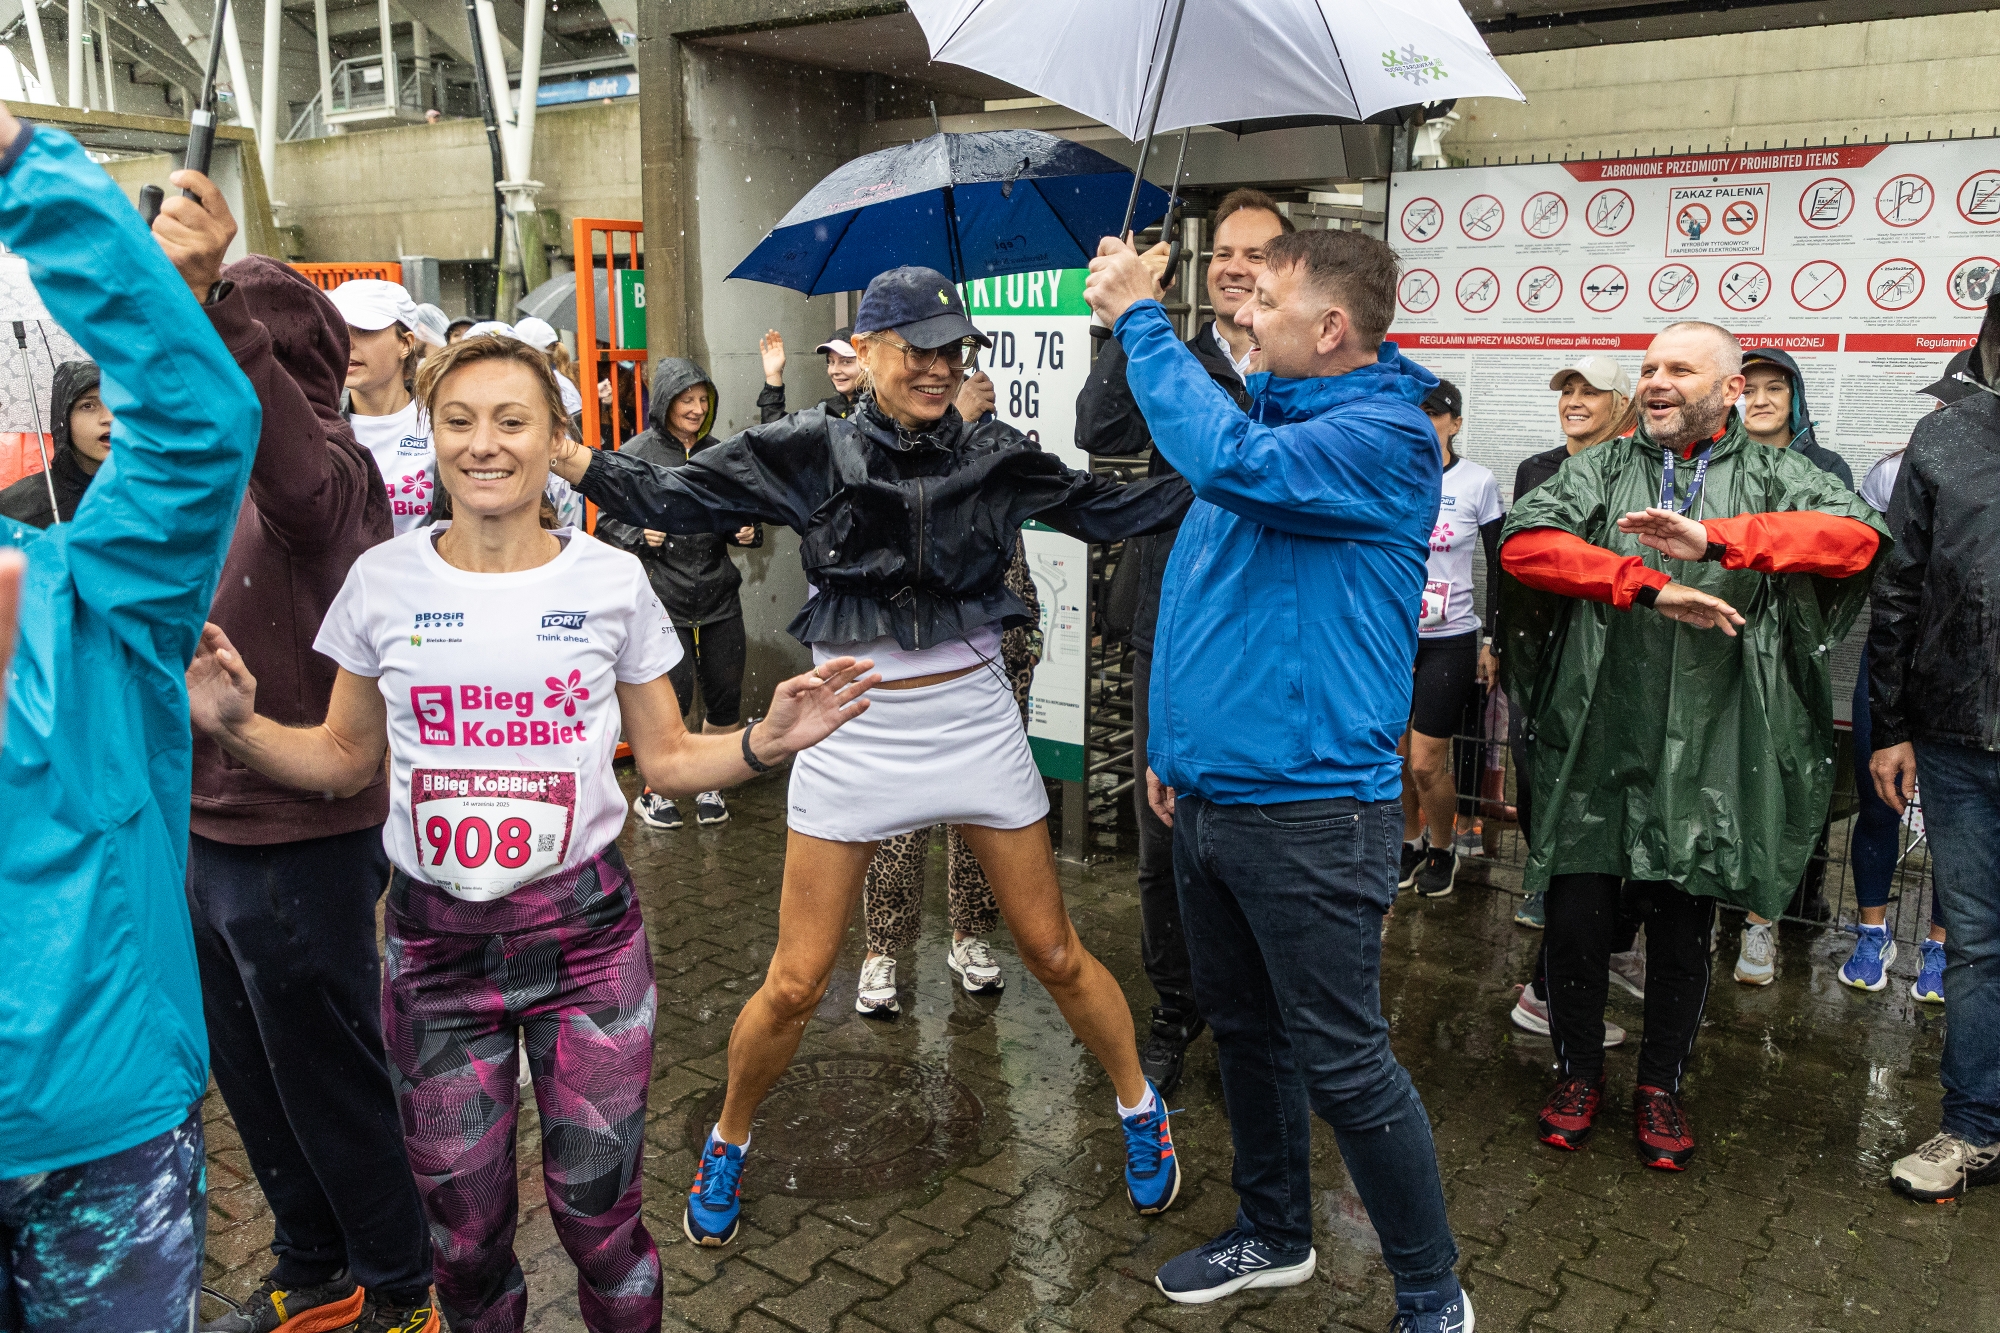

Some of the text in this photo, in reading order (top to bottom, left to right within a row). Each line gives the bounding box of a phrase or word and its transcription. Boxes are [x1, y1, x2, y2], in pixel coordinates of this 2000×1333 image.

[588, 79, 618, 97] Bufet
[1601, 162, 1664, 178] ZABRONIONE
[1666, 159, 1730, 174] PRZEDMIOTY
[1740, 155, 1802, 171] PROHIBITED
[1804, 152, 1839, 167] ITEMS
[1675, 187, 1764, 199] ZAKAZ PALENIA
[1419, 335, 1620, 347] REGULAMIN IMPREZY MASOWEJ (meczu piłki nożnej)
[1760, 337, 1784, 347] PIŁKI
[1786, 336, 1825, 347] NOŻNEJ
[1916, 337, 1967, 349] Regulamin
[1034, 331, 1064, 370] 7G
[1009, 380, 1040, 419] 8G
[401, 440, 426, 448] TORK
[415, 612, 464, 622] BBOSiR
[543, 615, 585, 627] TORK
[536, 634, 592, 644] Think ahead.
[417, 692, 446, 724] 5
[460, 685, 534, 718] Bieg
[425, 725, 450, 741] km
[462, 720, 588, 748] KoBBiet
[434, 775, 468, 795] Bieg
[474, 775, 547, 793] KoBBiet
[425, 815, 532, 869] 908
